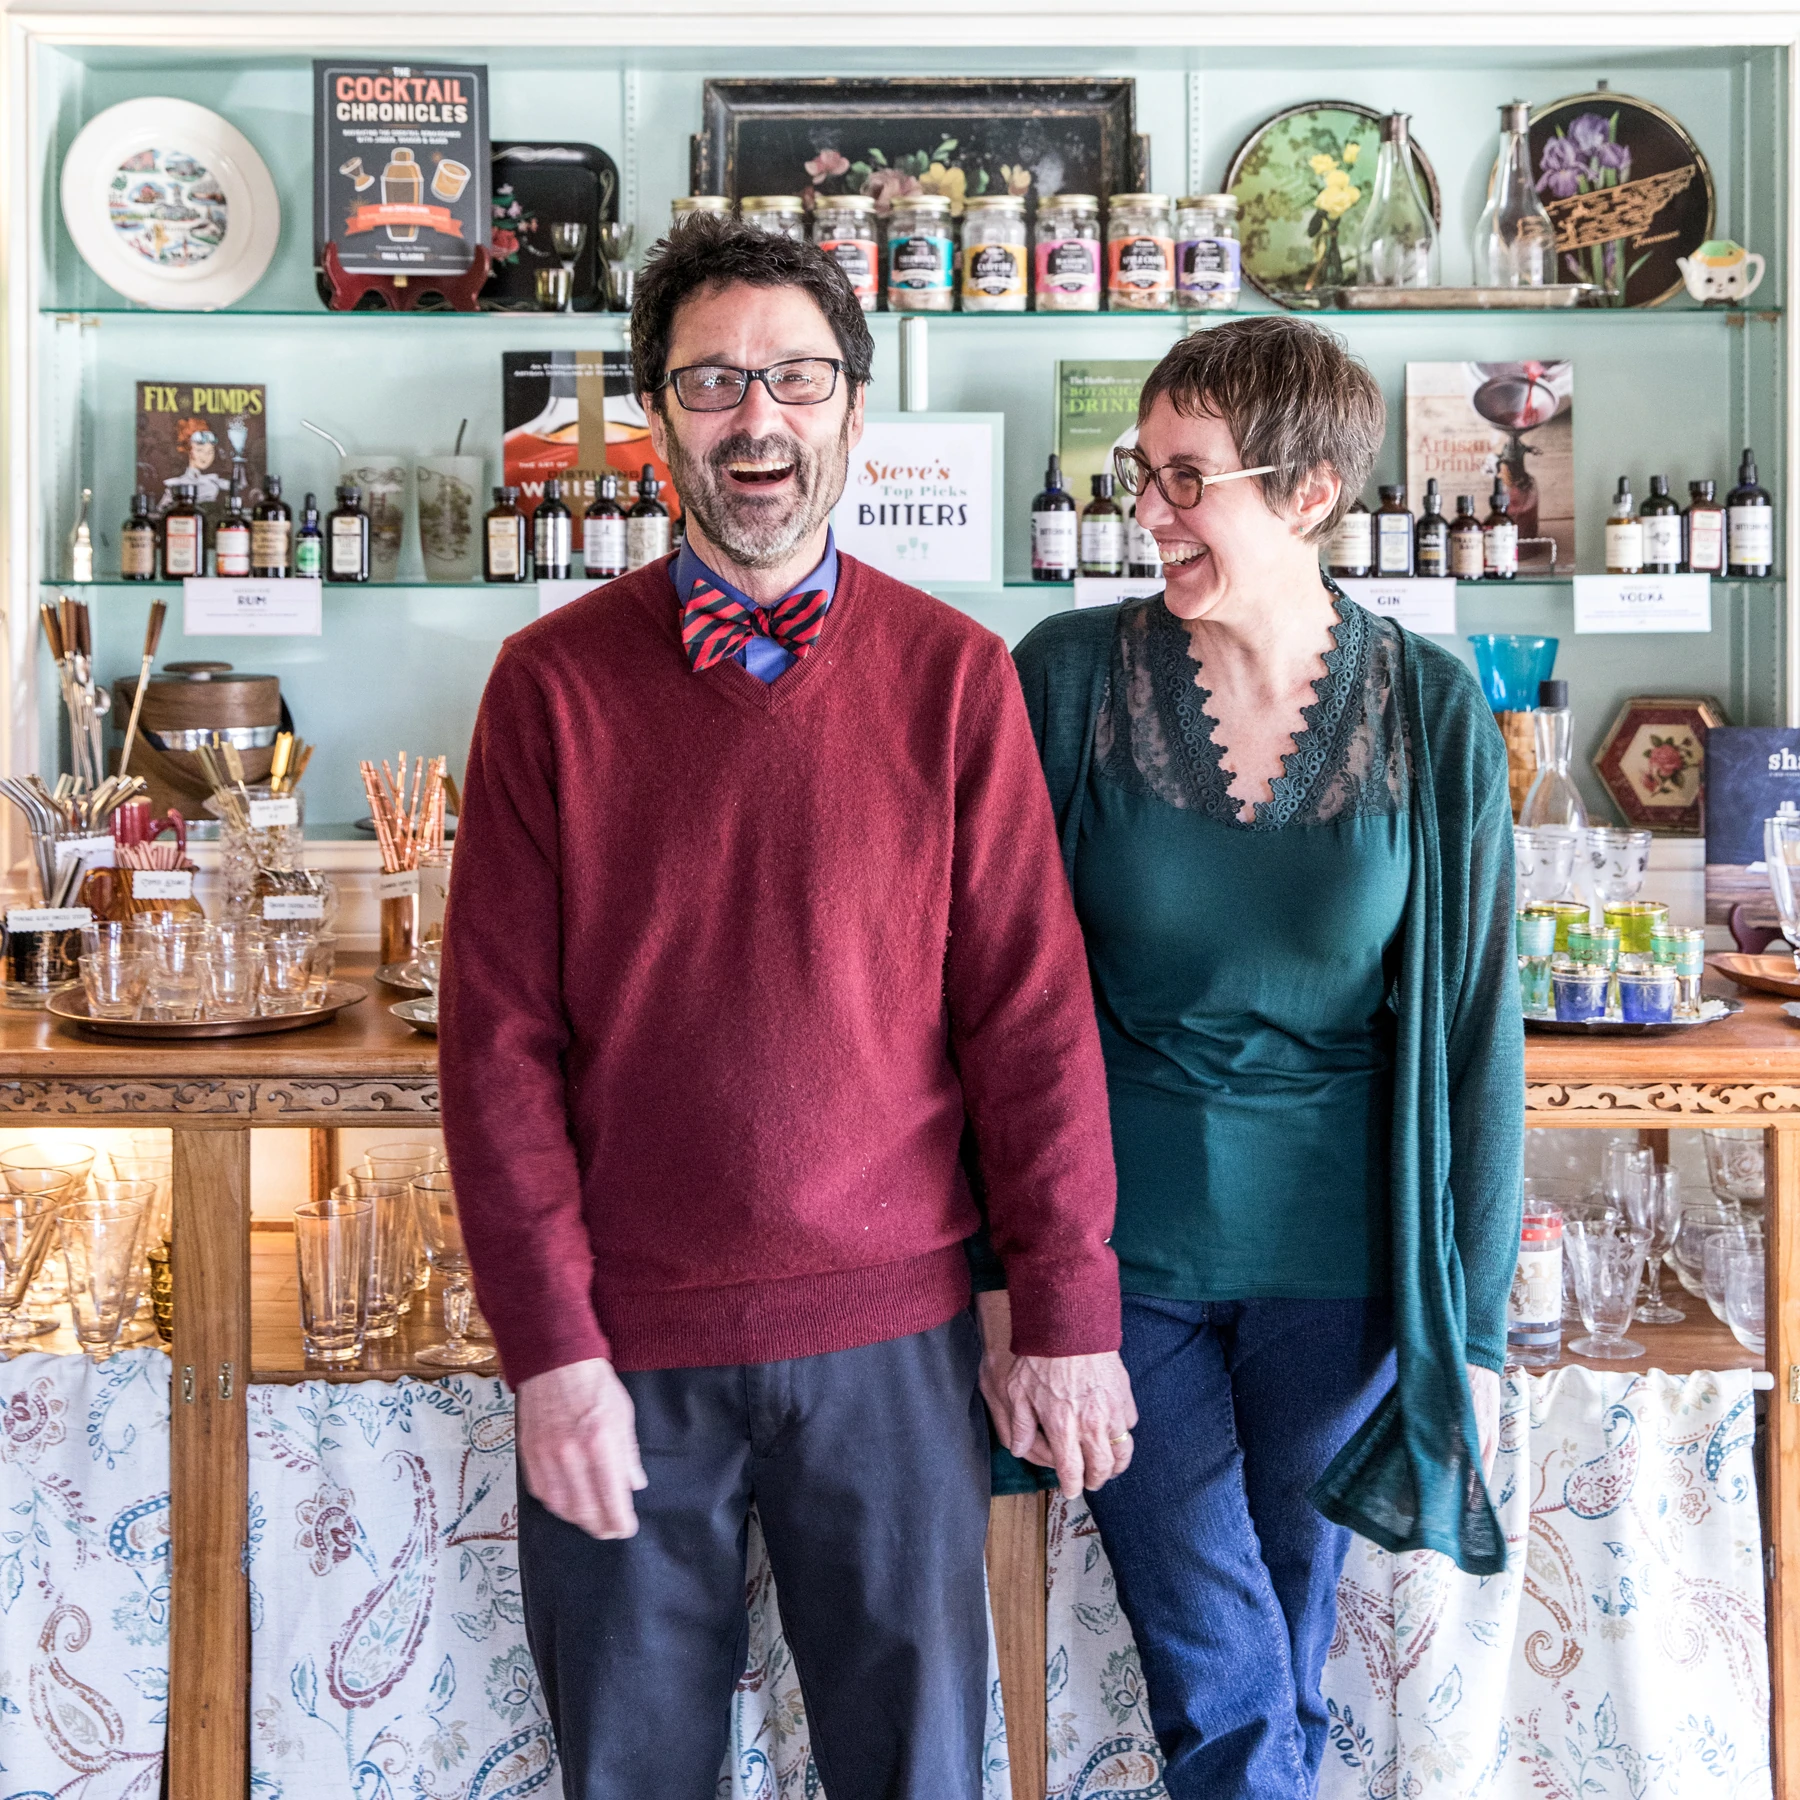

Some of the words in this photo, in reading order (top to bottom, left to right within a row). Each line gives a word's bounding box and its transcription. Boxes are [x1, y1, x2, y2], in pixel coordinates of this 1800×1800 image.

[392, 66, 411, 78] THE
[336, 76, 468, 104] COCKTAIL
[336, 102, 468, 124] CHRONICLES
[1070, 386, 1141, 397] BOTANICA
[144, 386, 178, 413] FIX
[193, 387, 263, 415] PUMPS
[1070, 398, 1138, 413] DRINK
[1417, 435, 1493, 454] Artisan
[858, 459, 950, 486] Steve's
[881, 486, 914, 499] Top
[920, 486, 968, 497] Picks
[858, 504, 968, 526] BITTERS
[237, 595, 267, 605] RUM
[1377, 596, 1401, 606] GIN
[1619, 592, 1665, 602] VODKA
